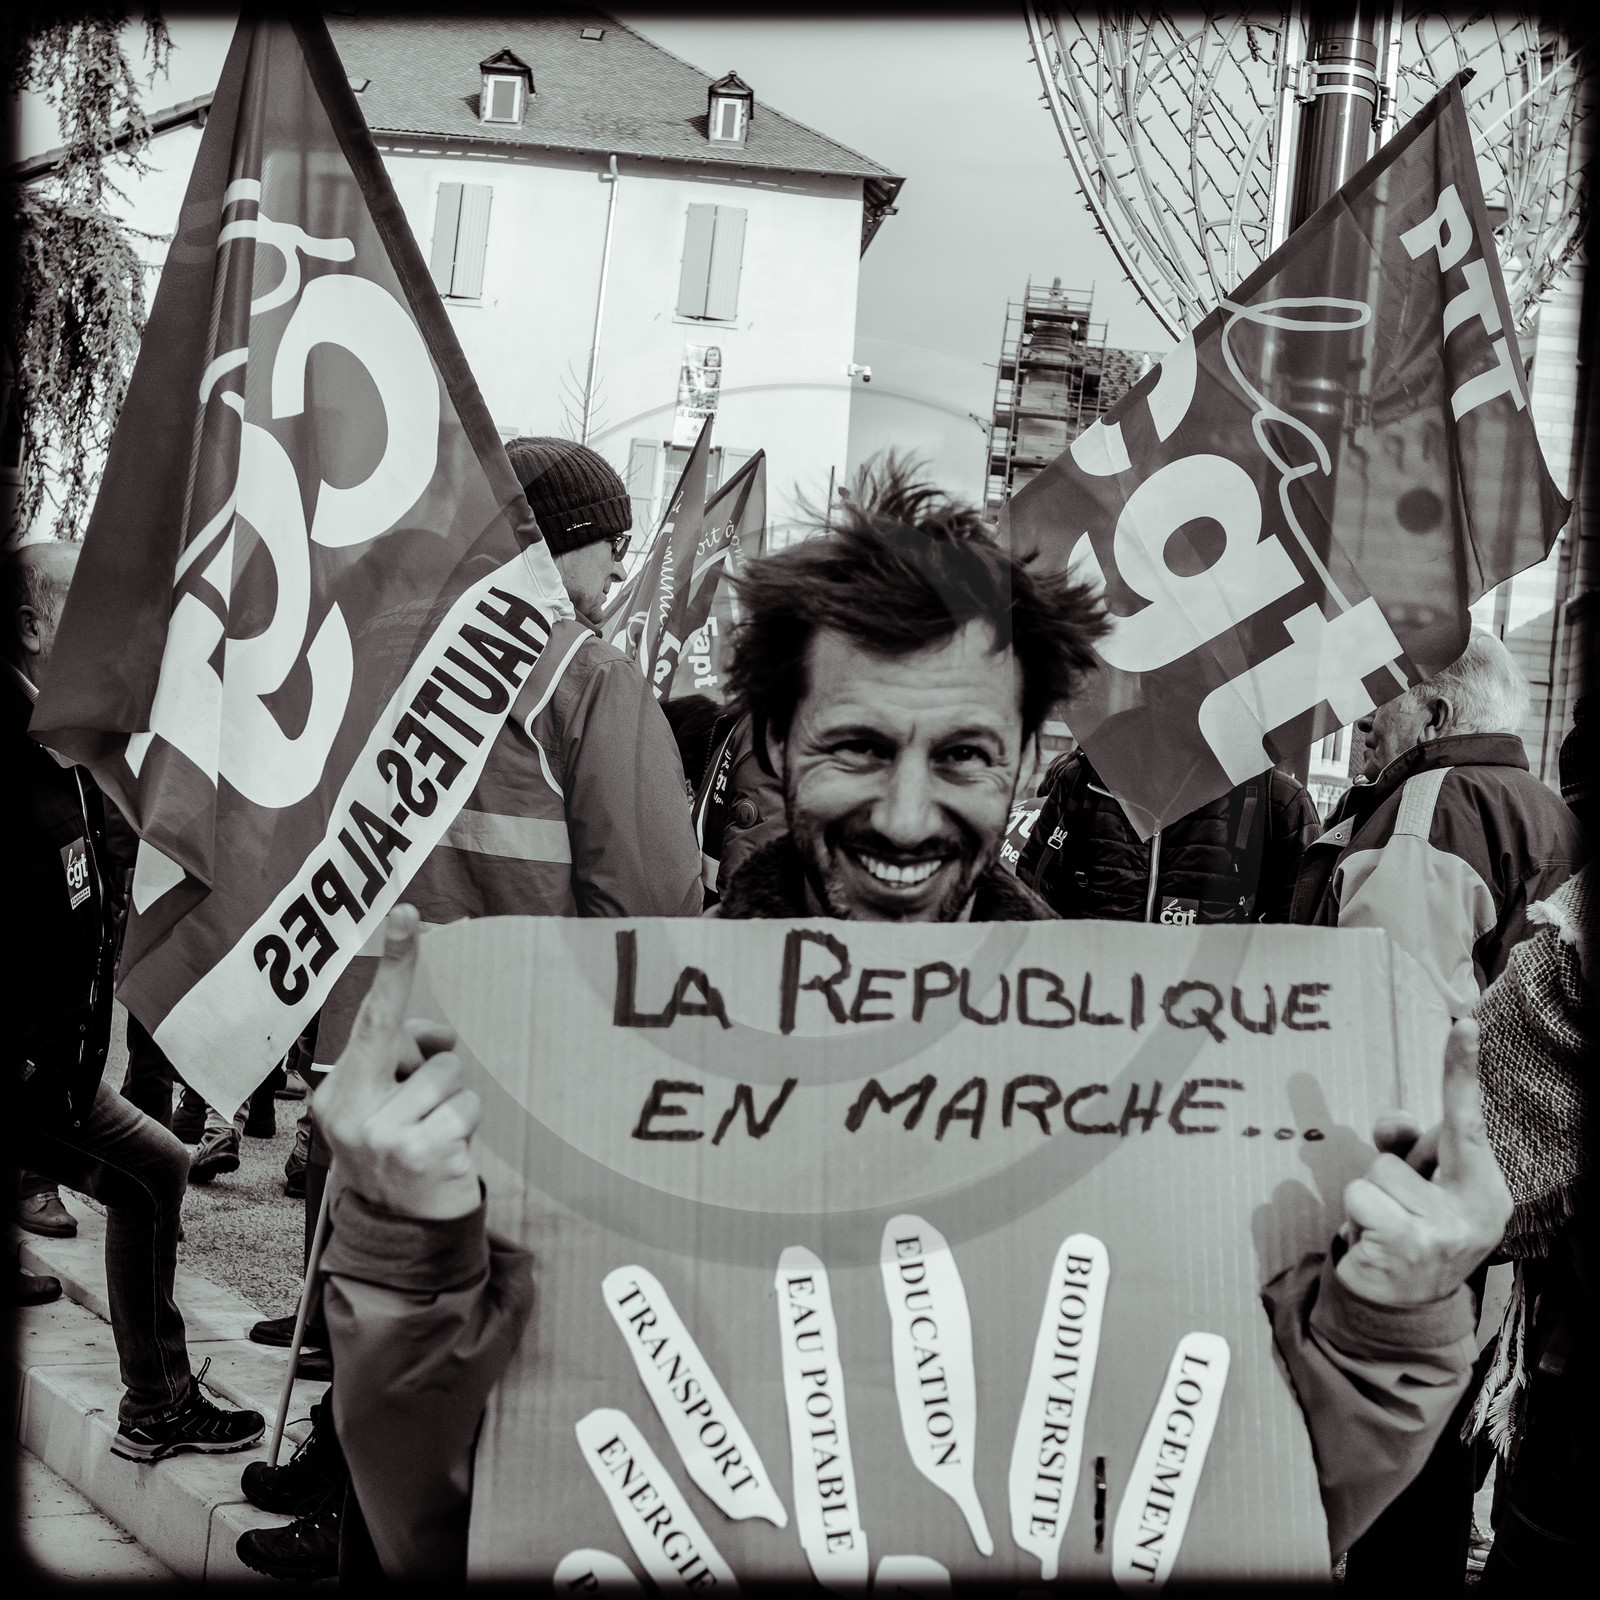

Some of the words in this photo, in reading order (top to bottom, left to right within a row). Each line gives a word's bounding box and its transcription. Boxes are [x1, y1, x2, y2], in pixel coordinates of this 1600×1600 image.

[688, 616, 719, 689] Fapt
[66, 852, 89, 889] cgt
[1160, 909, 1197, 926] cgt
[612, 928, 734, 1031] LA
[779, 928, 1335, 1043] REPUBLIQUE
[630, 1076, 799, 1146] EN
[787, 1275, 825, 1354] EAU
[895, 1235, 961, 1467] EDUCATION
[617, 1280, 760, 1496] TRANSPORT
[1029, 1253, 1094, 1539] BIODIVERSITE
[595, 1433, 718, 1590] ENERGIE
[801, 1368, 855, 1555] POTABLE
[1129, 1353, 1211, 1584] LOGEMENT
